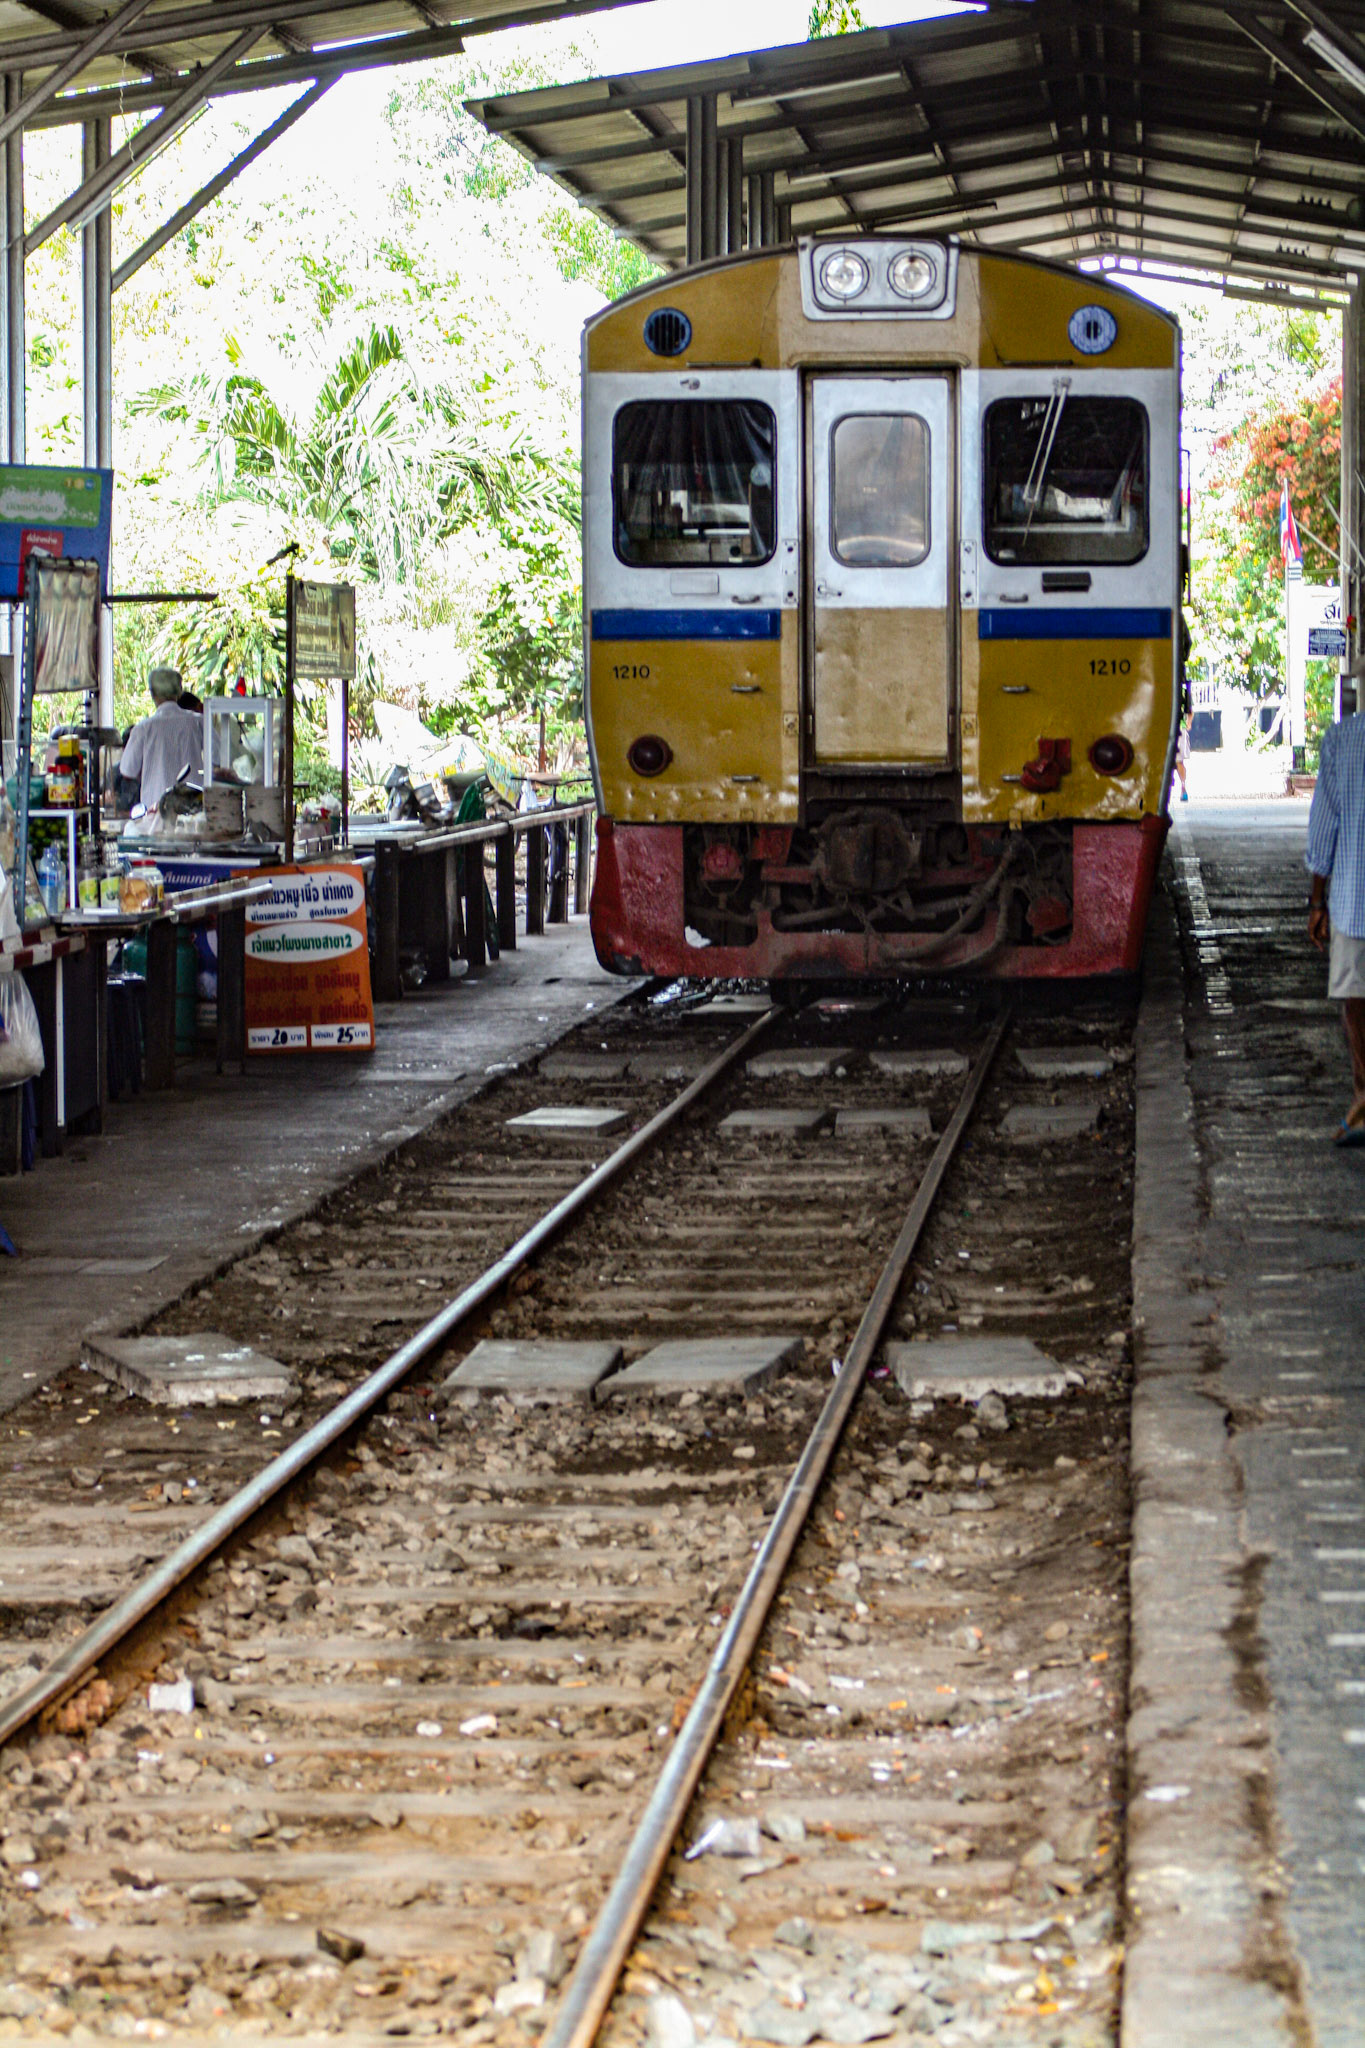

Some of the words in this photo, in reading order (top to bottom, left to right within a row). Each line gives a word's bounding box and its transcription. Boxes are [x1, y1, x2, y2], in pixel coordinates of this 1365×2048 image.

[613, 665, 650, 679] 1210
[1090, 659, 1131, 675] 1210
[272, 1029, 288, 1045] 20
[337, 1026, 355, 1043] 25
